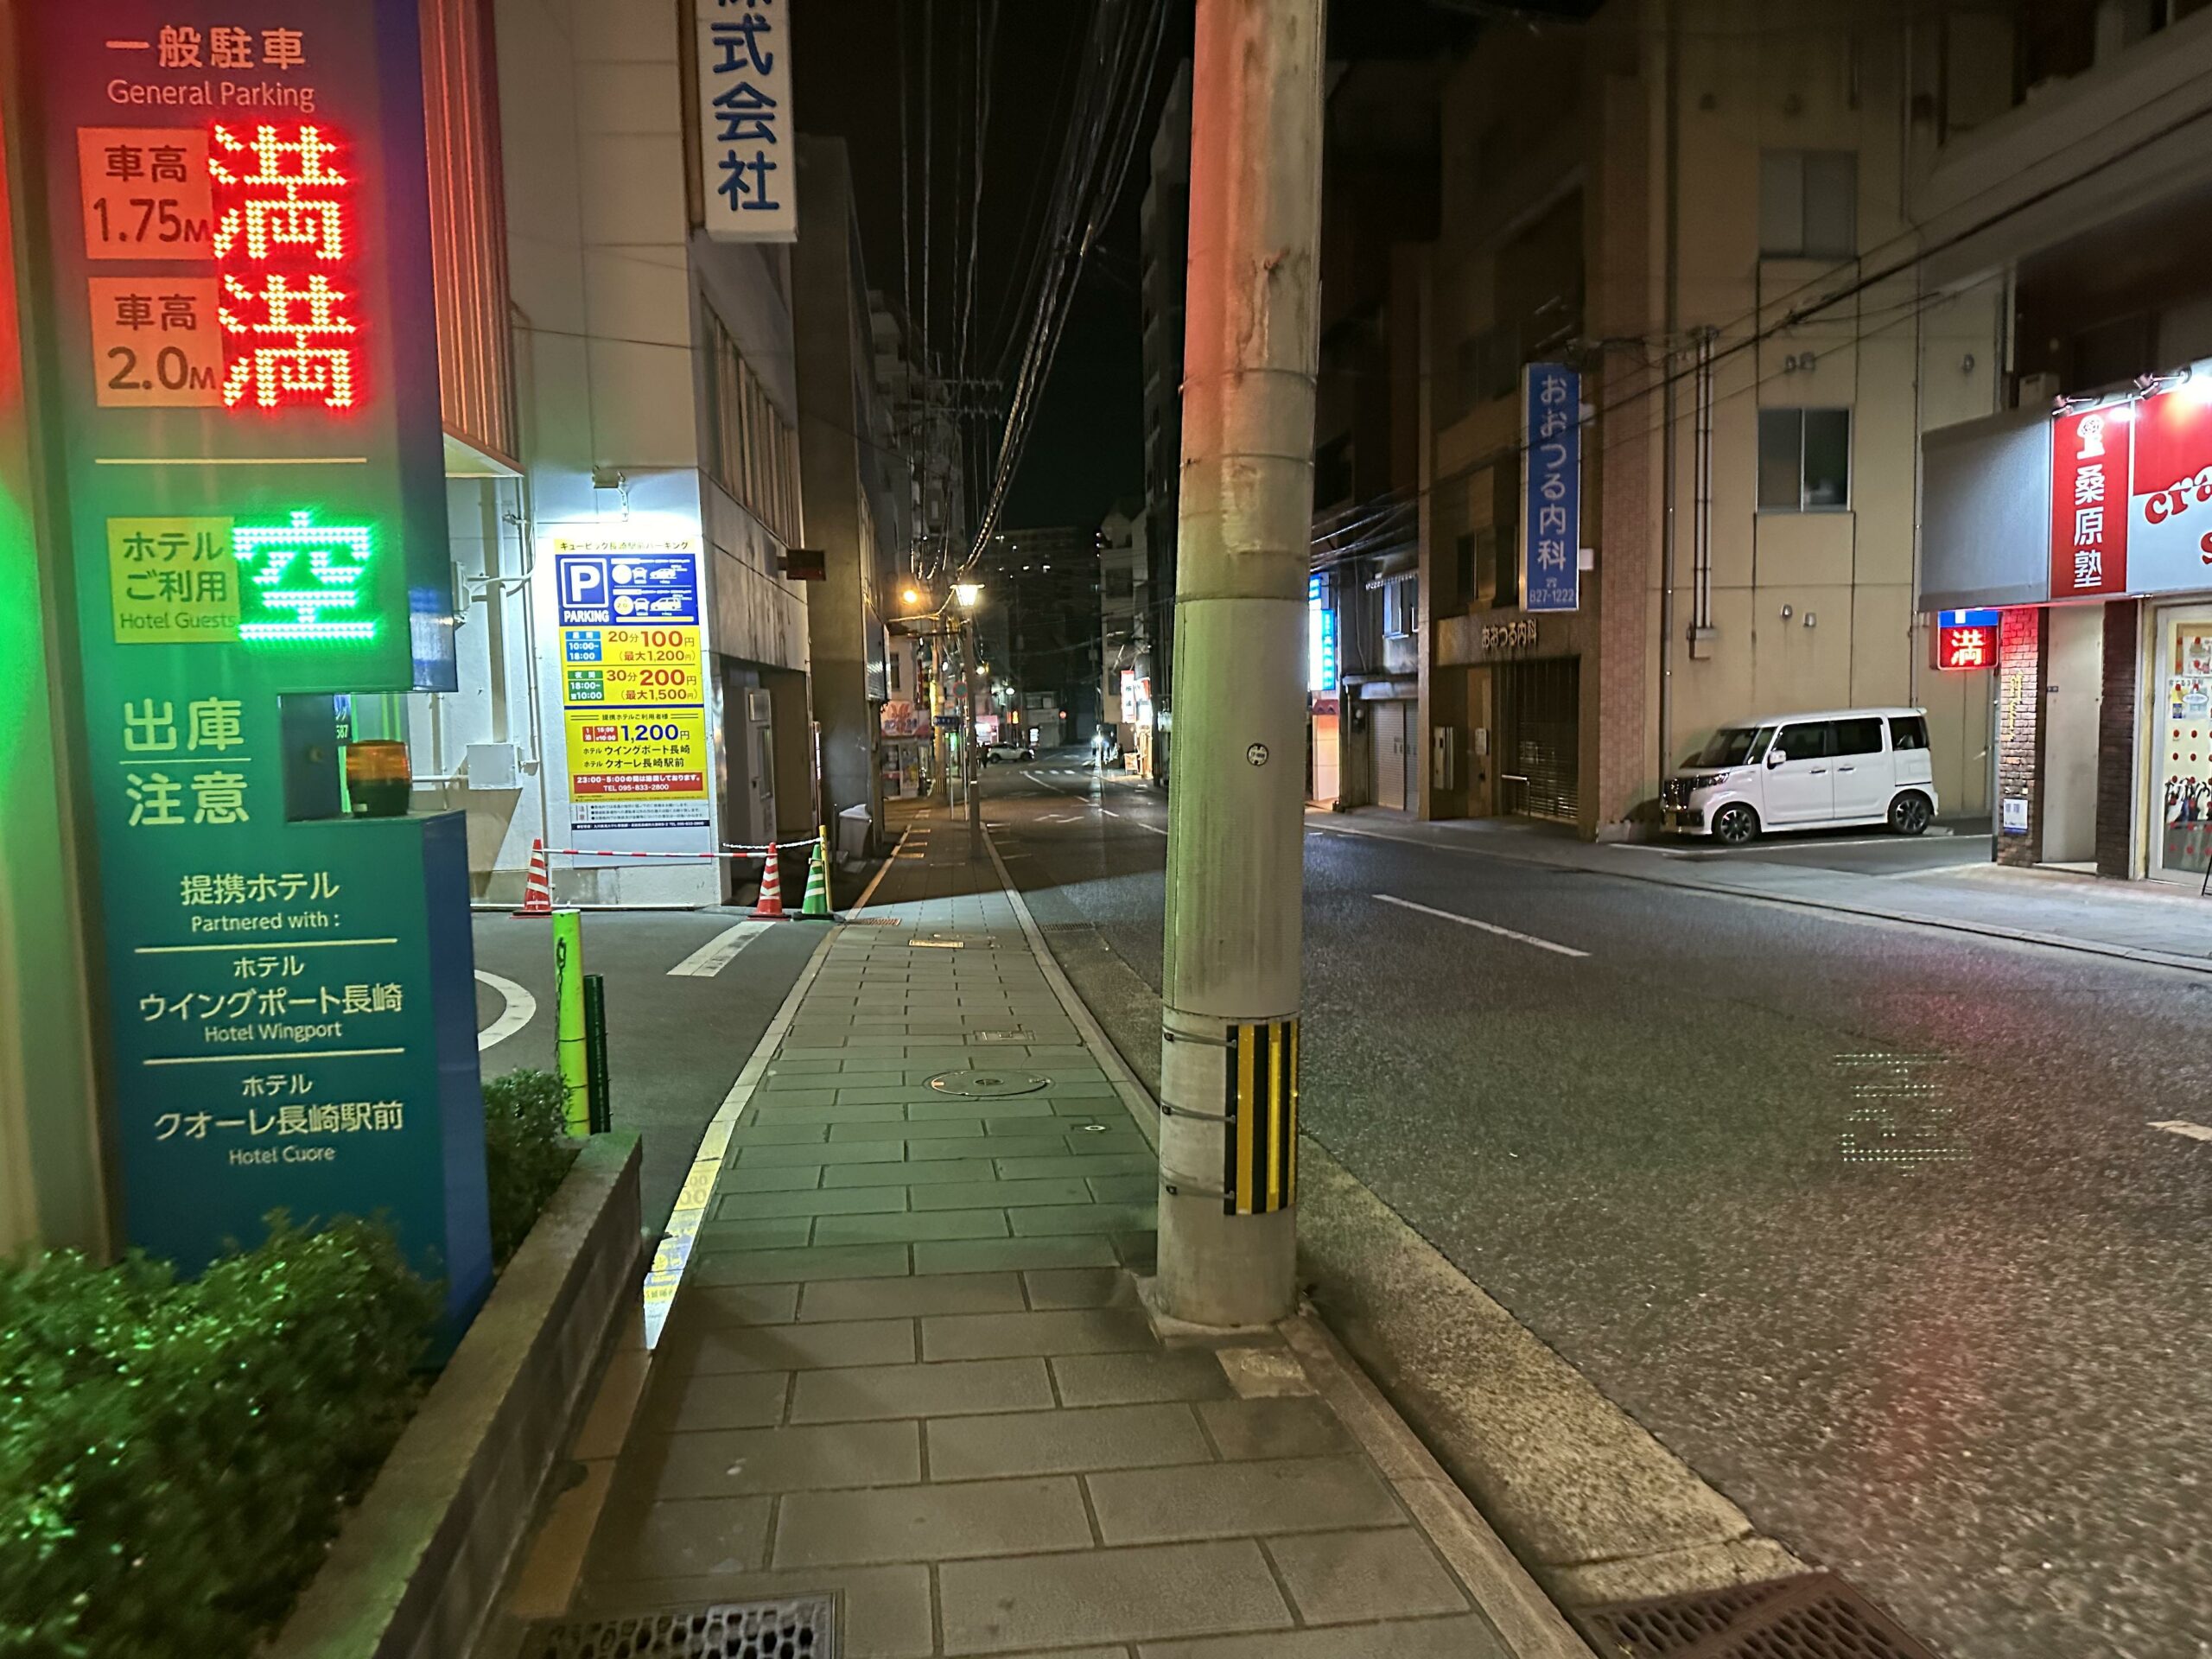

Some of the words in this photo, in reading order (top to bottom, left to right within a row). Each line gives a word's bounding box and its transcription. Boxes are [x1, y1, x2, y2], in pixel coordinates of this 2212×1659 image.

[106, 25, 306, 70] 一般駐車
[107, 79, 213, 106] General
[219, 81, 315, 112] Parking
[710, 0, 779, 211] 式会社
[105, 144, 188, 182] 車高
[208, 124, 347, 259] 満
[93, 198, 209, 243] 1.75M
[114, 294, 198, 332] 車高
[218, 274, 357, 407] 満
[107, 346, 216, 391] 2.0M
[1537, 373, 1567, 571] おおつる内科
[2073, 463, 2106, 588] 桑原塾
[123, 531, 224, 563] ホテル
[126, 570, 227, 603] ご利用
[232, 511, 377, 641] 空
[569, 565, 601, 602] P
[1529, 588, 1574, 603] 827-1222
[120, 612, 170, 630] Hotel
[175, 610, 237, 631] Guests
[563, 609, 610, 623] PARKING
[1481, 618, 1537, 651] おおつる内科
[1951, 628, 1986, 665] 満
[124, 696, 246, 752] 出庫
[620, 724, 690, 743] 1,200円
[605, 758, 684, 768] クオーレ長崎駅前
[126, 771, 249, 827] 注意
[180, 872, 341, 906] 提携ホテル
[191, 913, 283, 933] Partnered
[287, 912, 329, 929] with
[233, 955, 305, 979] ホテル
[138, 982, 404, 1022] ウイングポート長崎
[204, 1024, 254, 1043] Hotel
[258, 1021, 343, 1043] Wingport
[241, 1073, 314, 1097] ホテル
[154, 1101, 404, 1141] クオーレ長崎駅前
[229, 1147, 278, 1166] Hotel
[282, 1146, 336, 1164] Cuore
